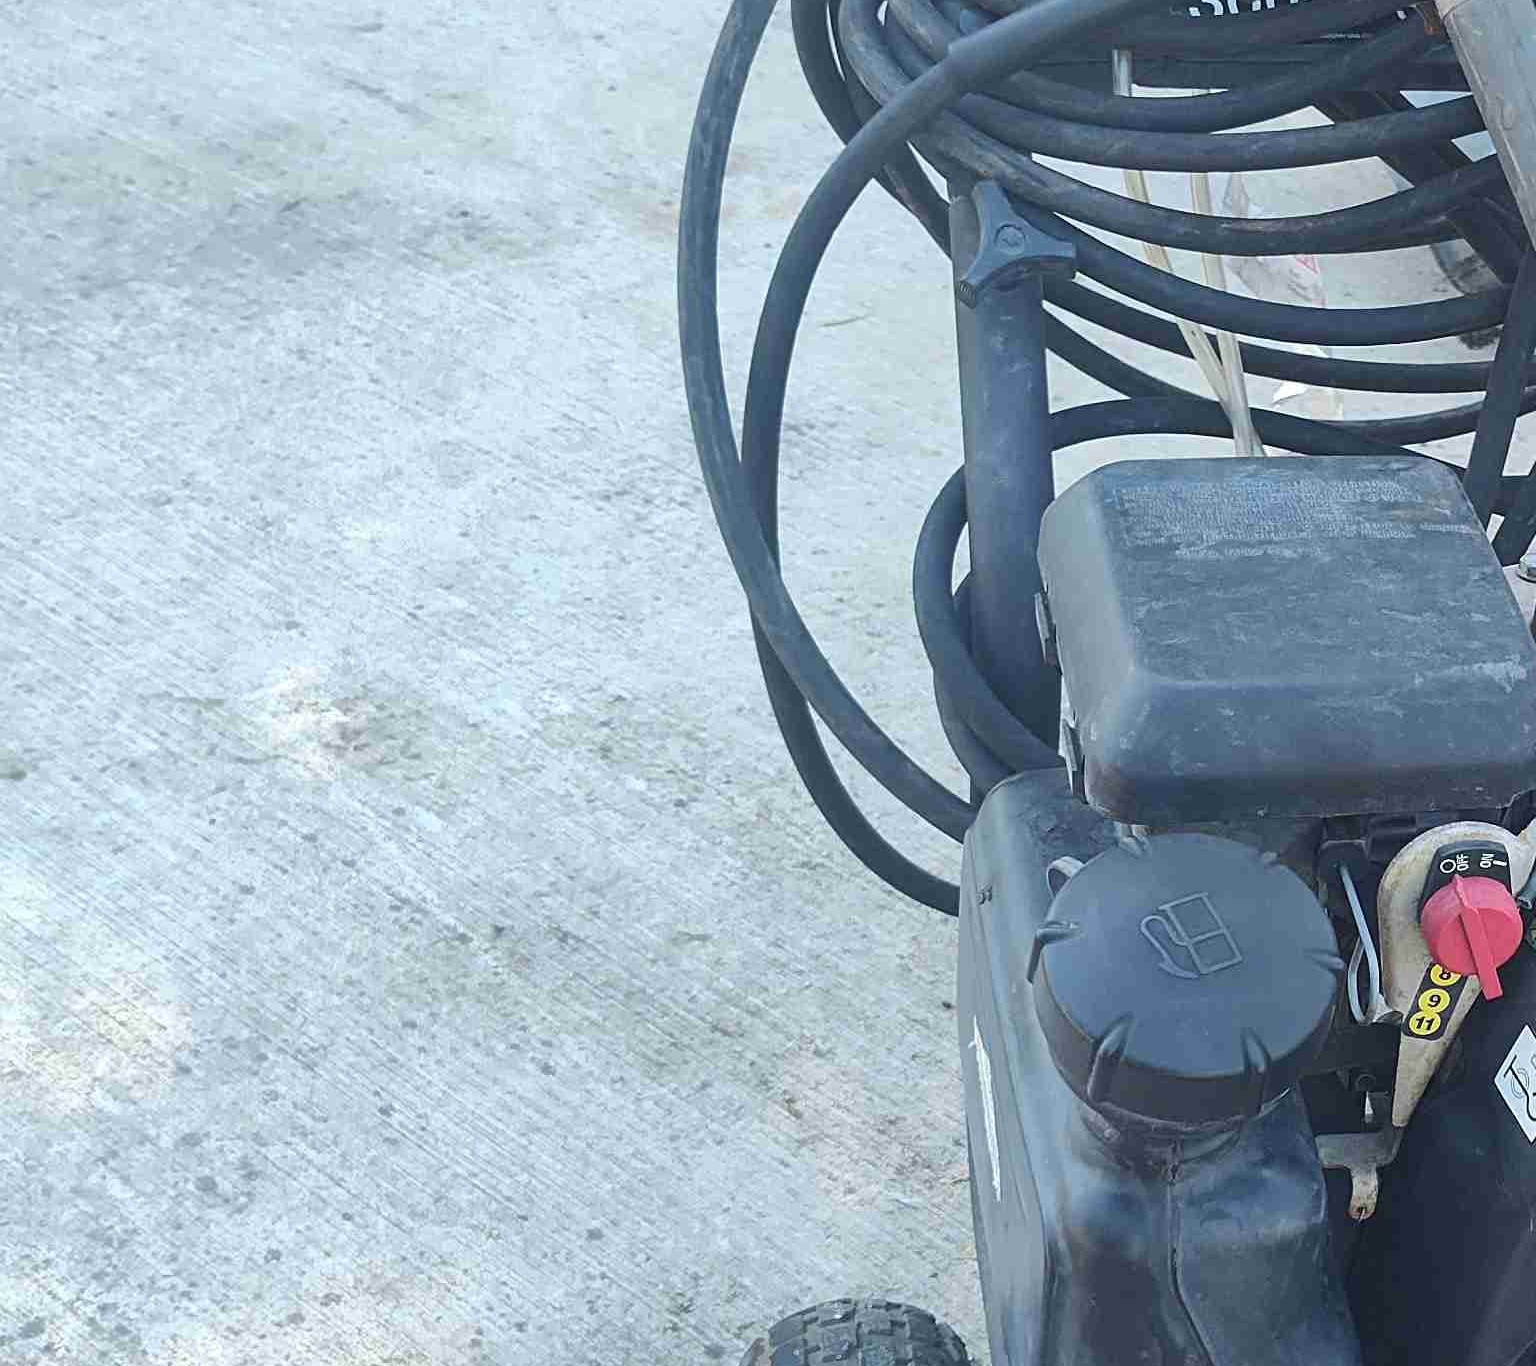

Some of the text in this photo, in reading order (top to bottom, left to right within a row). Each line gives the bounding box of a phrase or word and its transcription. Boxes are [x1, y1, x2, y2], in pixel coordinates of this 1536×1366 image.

[1456, 853, 1470, 872] OFF
[1479, 852, 1495, 869] ON
[1428, 994, 1442, 1008] 9
[1414, 1016, 1435, 1031] 11
